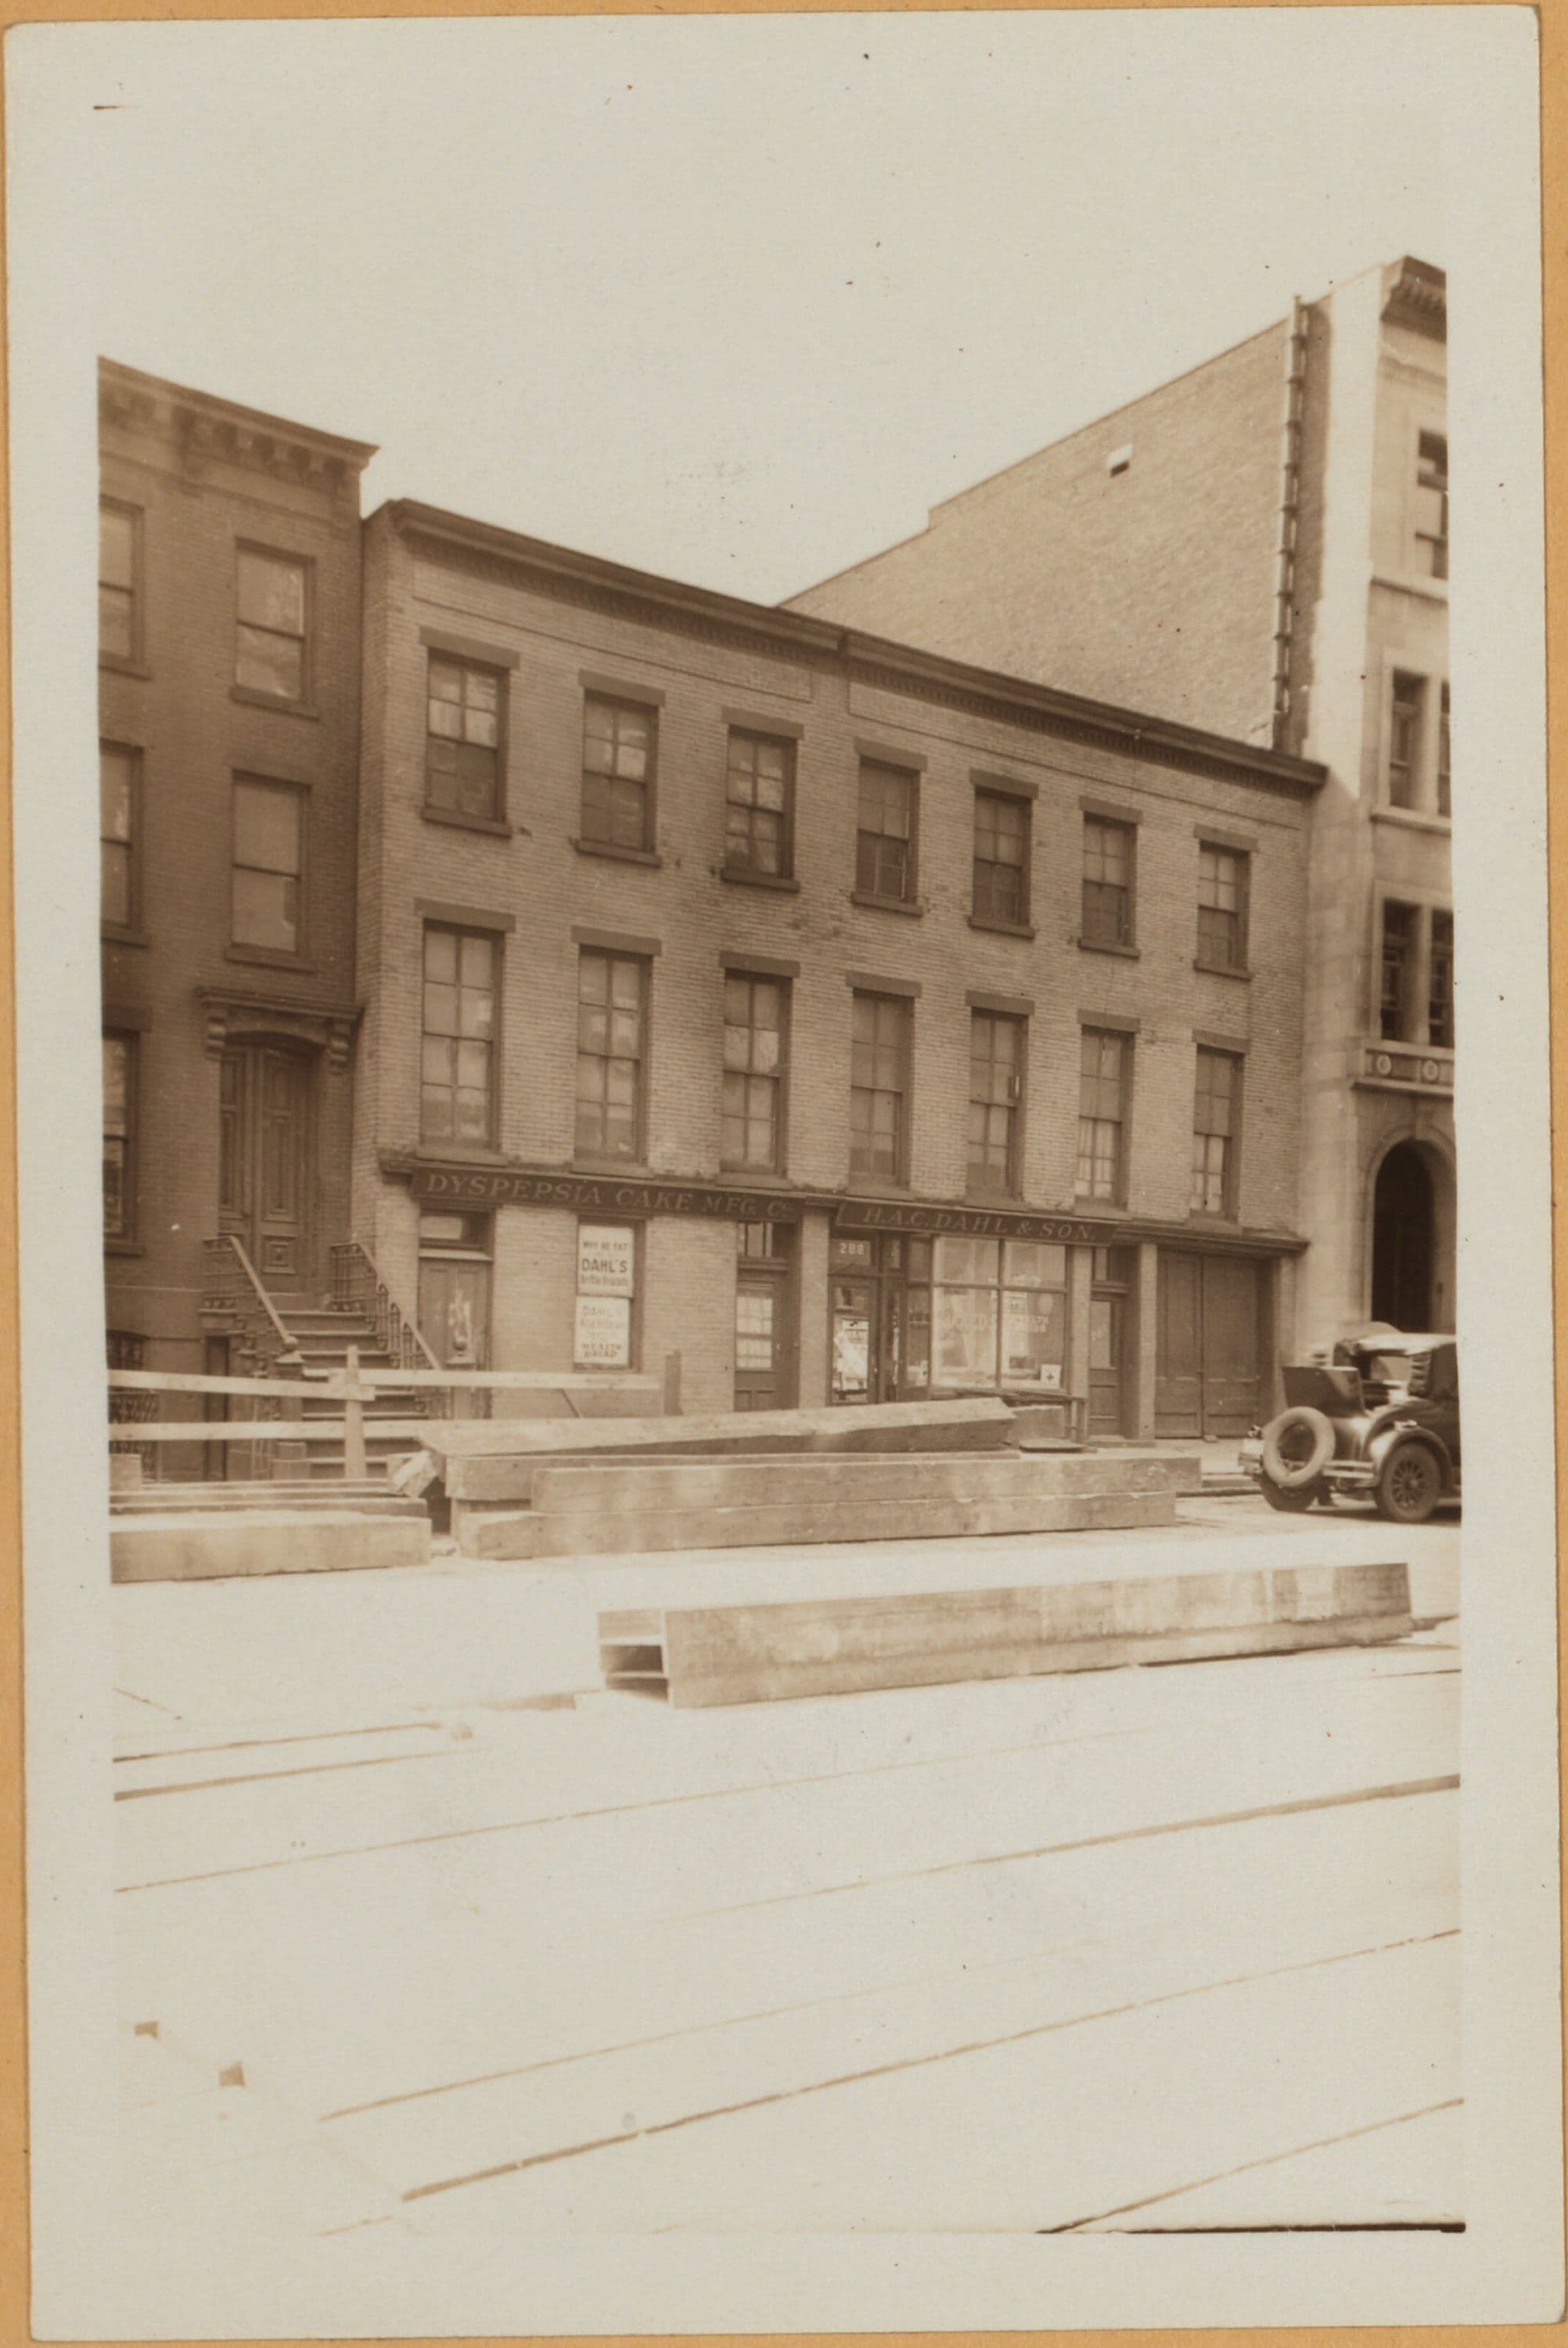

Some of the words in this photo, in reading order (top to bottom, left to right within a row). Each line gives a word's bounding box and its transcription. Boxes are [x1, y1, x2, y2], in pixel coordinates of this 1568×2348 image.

[427, 1174, 603, 1204] DYSPEPSIA
[615, 1187, 694, 1211] CAKE
[703, 1194, 757, 1215] MFG
[936, 1213, 1007, 1233] DAHL
[1018, 1219, 1034, 1235] &
[581, 1258, 627, 1273] DAHL'S
